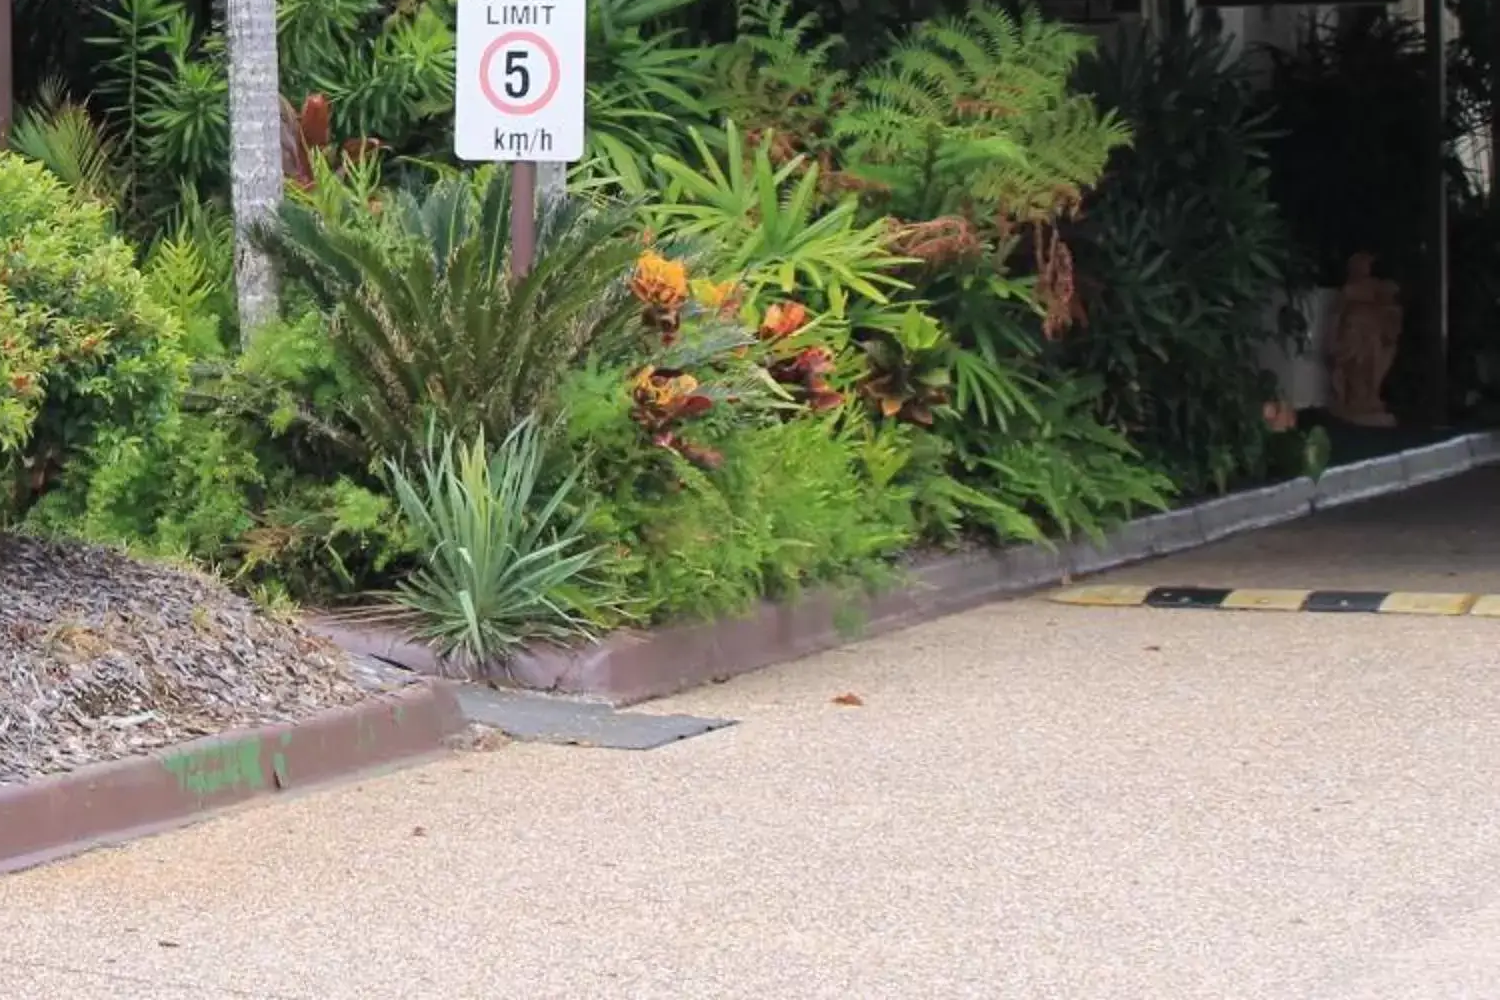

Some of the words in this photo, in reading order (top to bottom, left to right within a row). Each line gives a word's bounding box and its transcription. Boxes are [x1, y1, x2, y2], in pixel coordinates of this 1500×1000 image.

[486, 5, 556, 25] LIMIT
[504, 50, 530, 99] 5
[494, 127, 553, 152] km/h
